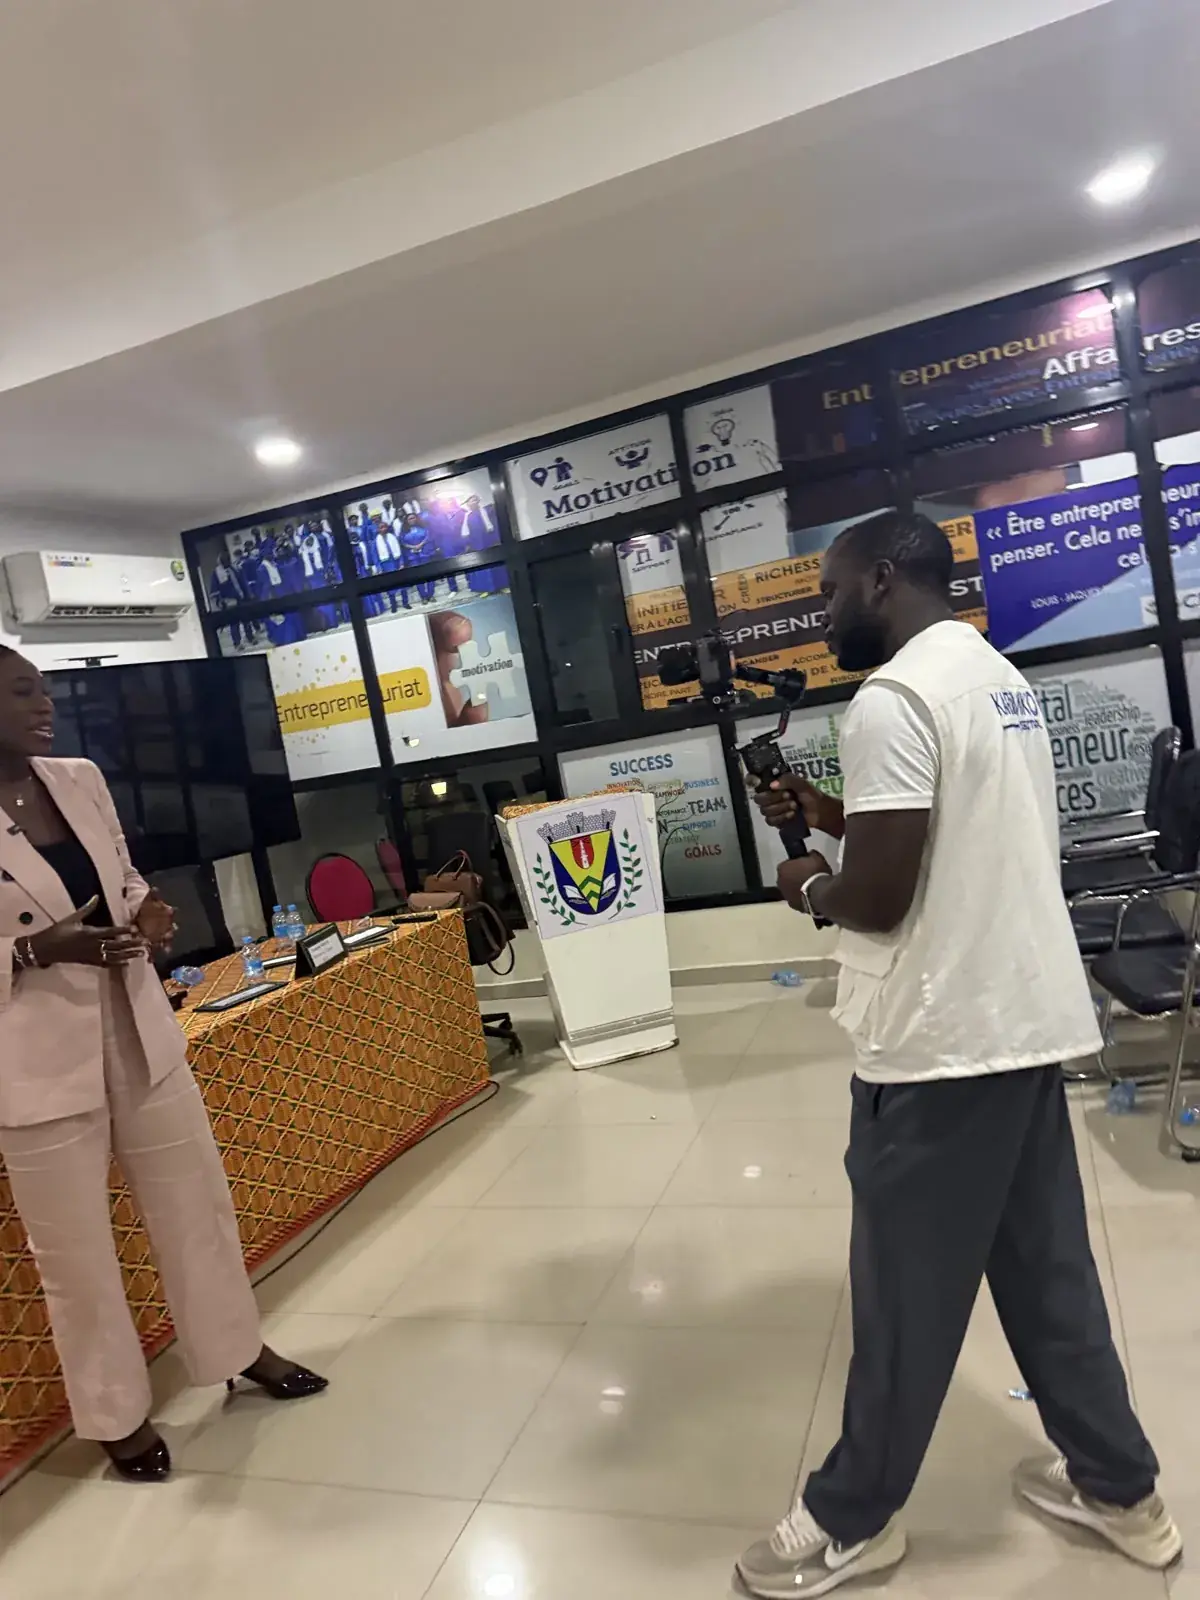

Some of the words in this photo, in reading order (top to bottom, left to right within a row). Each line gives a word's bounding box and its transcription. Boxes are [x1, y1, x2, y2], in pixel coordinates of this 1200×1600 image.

[1007, 511, 1046, 536] Être
[990, 541, 1060, 573] penser.
[1064, 525, 1112, 551] Cela
[1117, 523, 1143, 541] ne
[461, 657, 514, 679] motivation
[610, 753, 673, 776] SUCCESS
[688, 796, 728, 815] TEAM
[684, 843, 722, 859] GOALS
